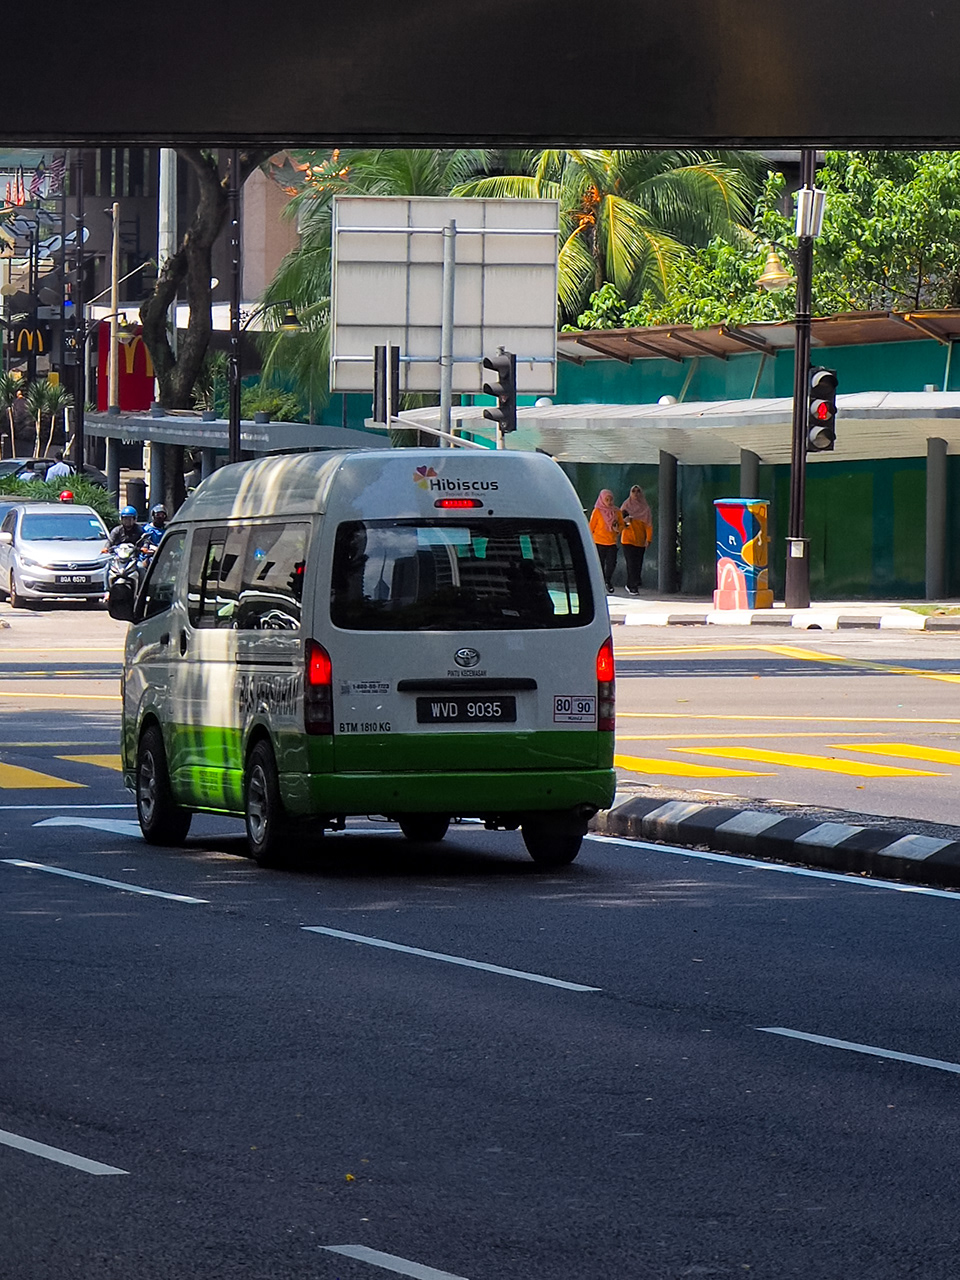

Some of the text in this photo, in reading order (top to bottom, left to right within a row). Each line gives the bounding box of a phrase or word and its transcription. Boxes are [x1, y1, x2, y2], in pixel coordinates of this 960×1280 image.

[430, 478, 499, 491] Hibiscus
[431, 702, 502, 718] WVD 9035
[556, 699, 570, 712] 80
[578, 702, 590, 712] 90
[339, 722, 391, 732] BTM 1810 KG
